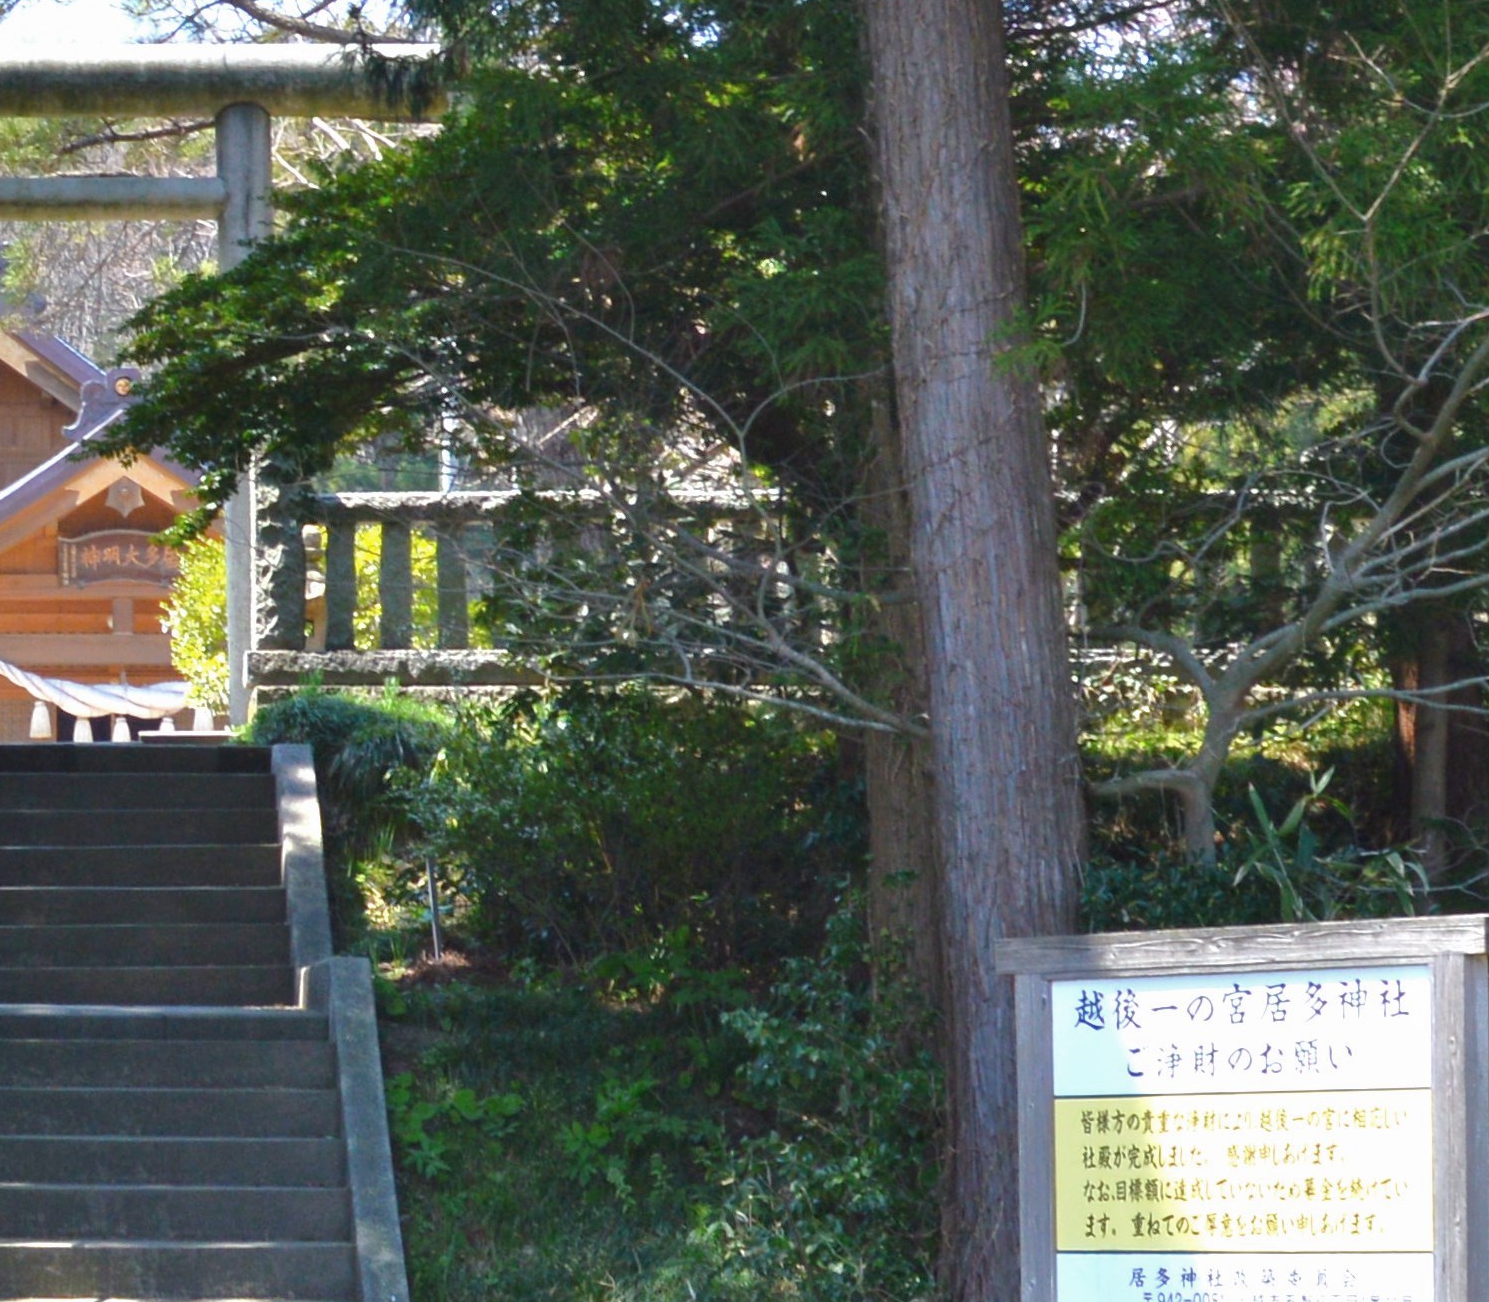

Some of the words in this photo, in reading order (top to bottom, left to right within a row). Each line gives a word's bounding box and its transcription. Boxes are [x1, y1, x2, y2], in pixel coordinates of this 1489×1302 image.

[1074, 979, 1410, 1030] 越後一の宮居多神社
[1127, 1039, 1353, 1079] ご浄財のお願い
